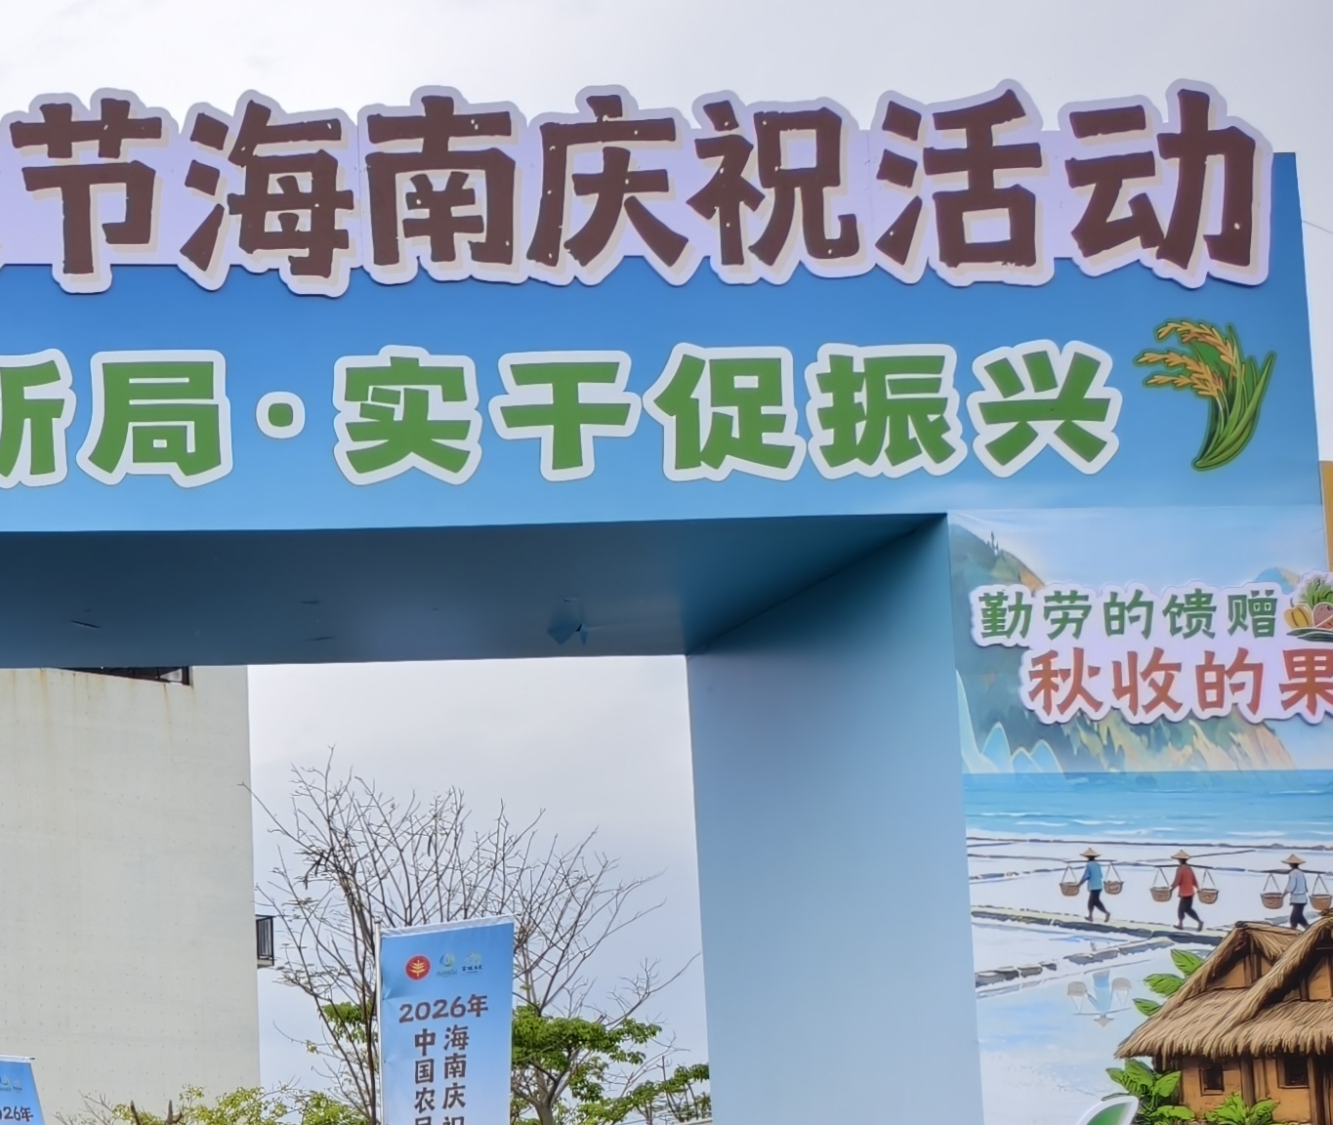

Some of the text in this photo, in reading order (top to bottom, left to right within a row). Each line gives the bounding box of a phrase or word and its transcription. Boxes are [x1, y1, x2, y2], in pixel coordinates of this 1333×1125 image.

[978, 588, 1279, 641] 勤劳的馈赠
[399, 994, 488, 1024] 2026年
